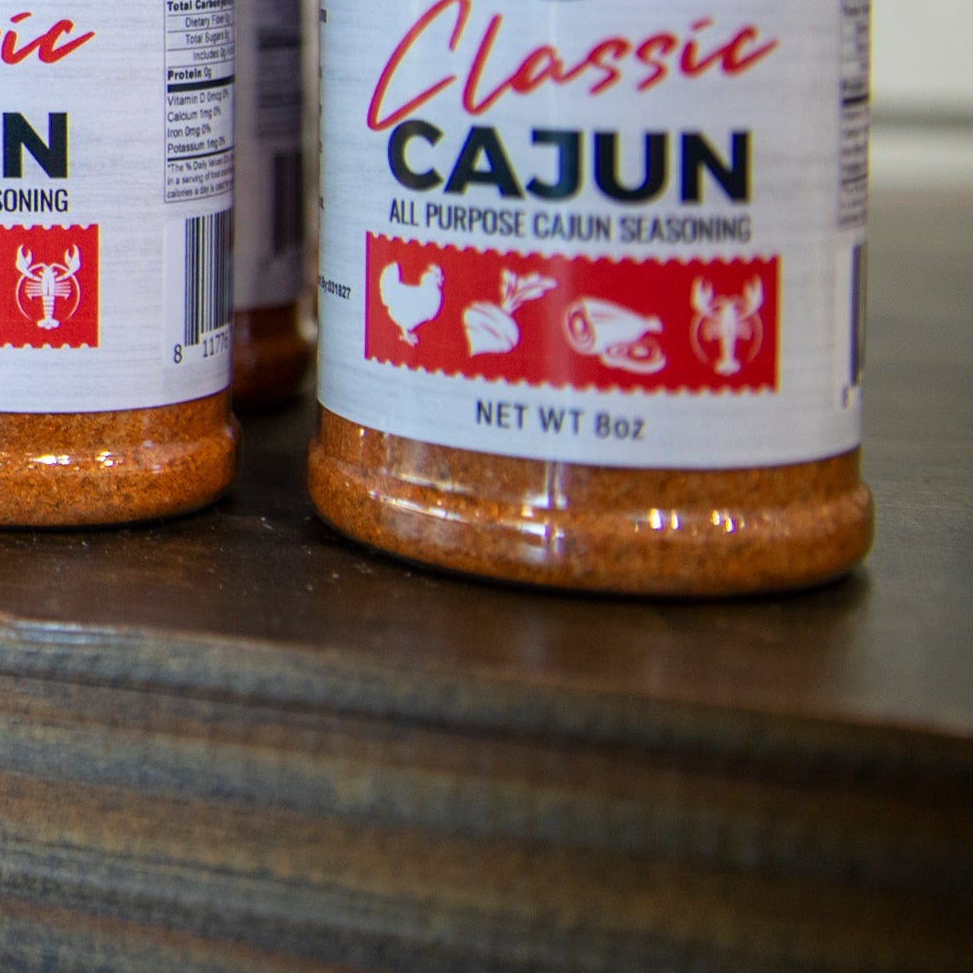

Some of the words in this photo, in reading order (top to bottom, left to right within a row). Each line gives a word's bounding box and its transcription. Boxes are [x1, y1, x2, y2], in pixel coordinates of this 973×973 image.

[167, 0, 192, 12] Total
[185, 34, 203, 45] Total
[168, 69, 201, 81] Protein
[167, 95, 198, 106] Vitamin
[200, 92, 205, 103] D
[167, 111, 198, 122] Calcium
[167, 128, 183, 138] Iron
[167, 141, 205, 154] Potassium
[387, 119, 753, 204] CAJUN
[389, 198, 419, 227] ALL
[426, 202, 525, 238] PURPOSE
[532, 209, 611, 242] CAJUN
[619, 214, 752, 245] SEASONING
[173, 343, 183, 364] 8
[477, 400, 528, 429] NET
[538, 407, 585, 437] WT
[595, 413, 646, 440] 8oz
